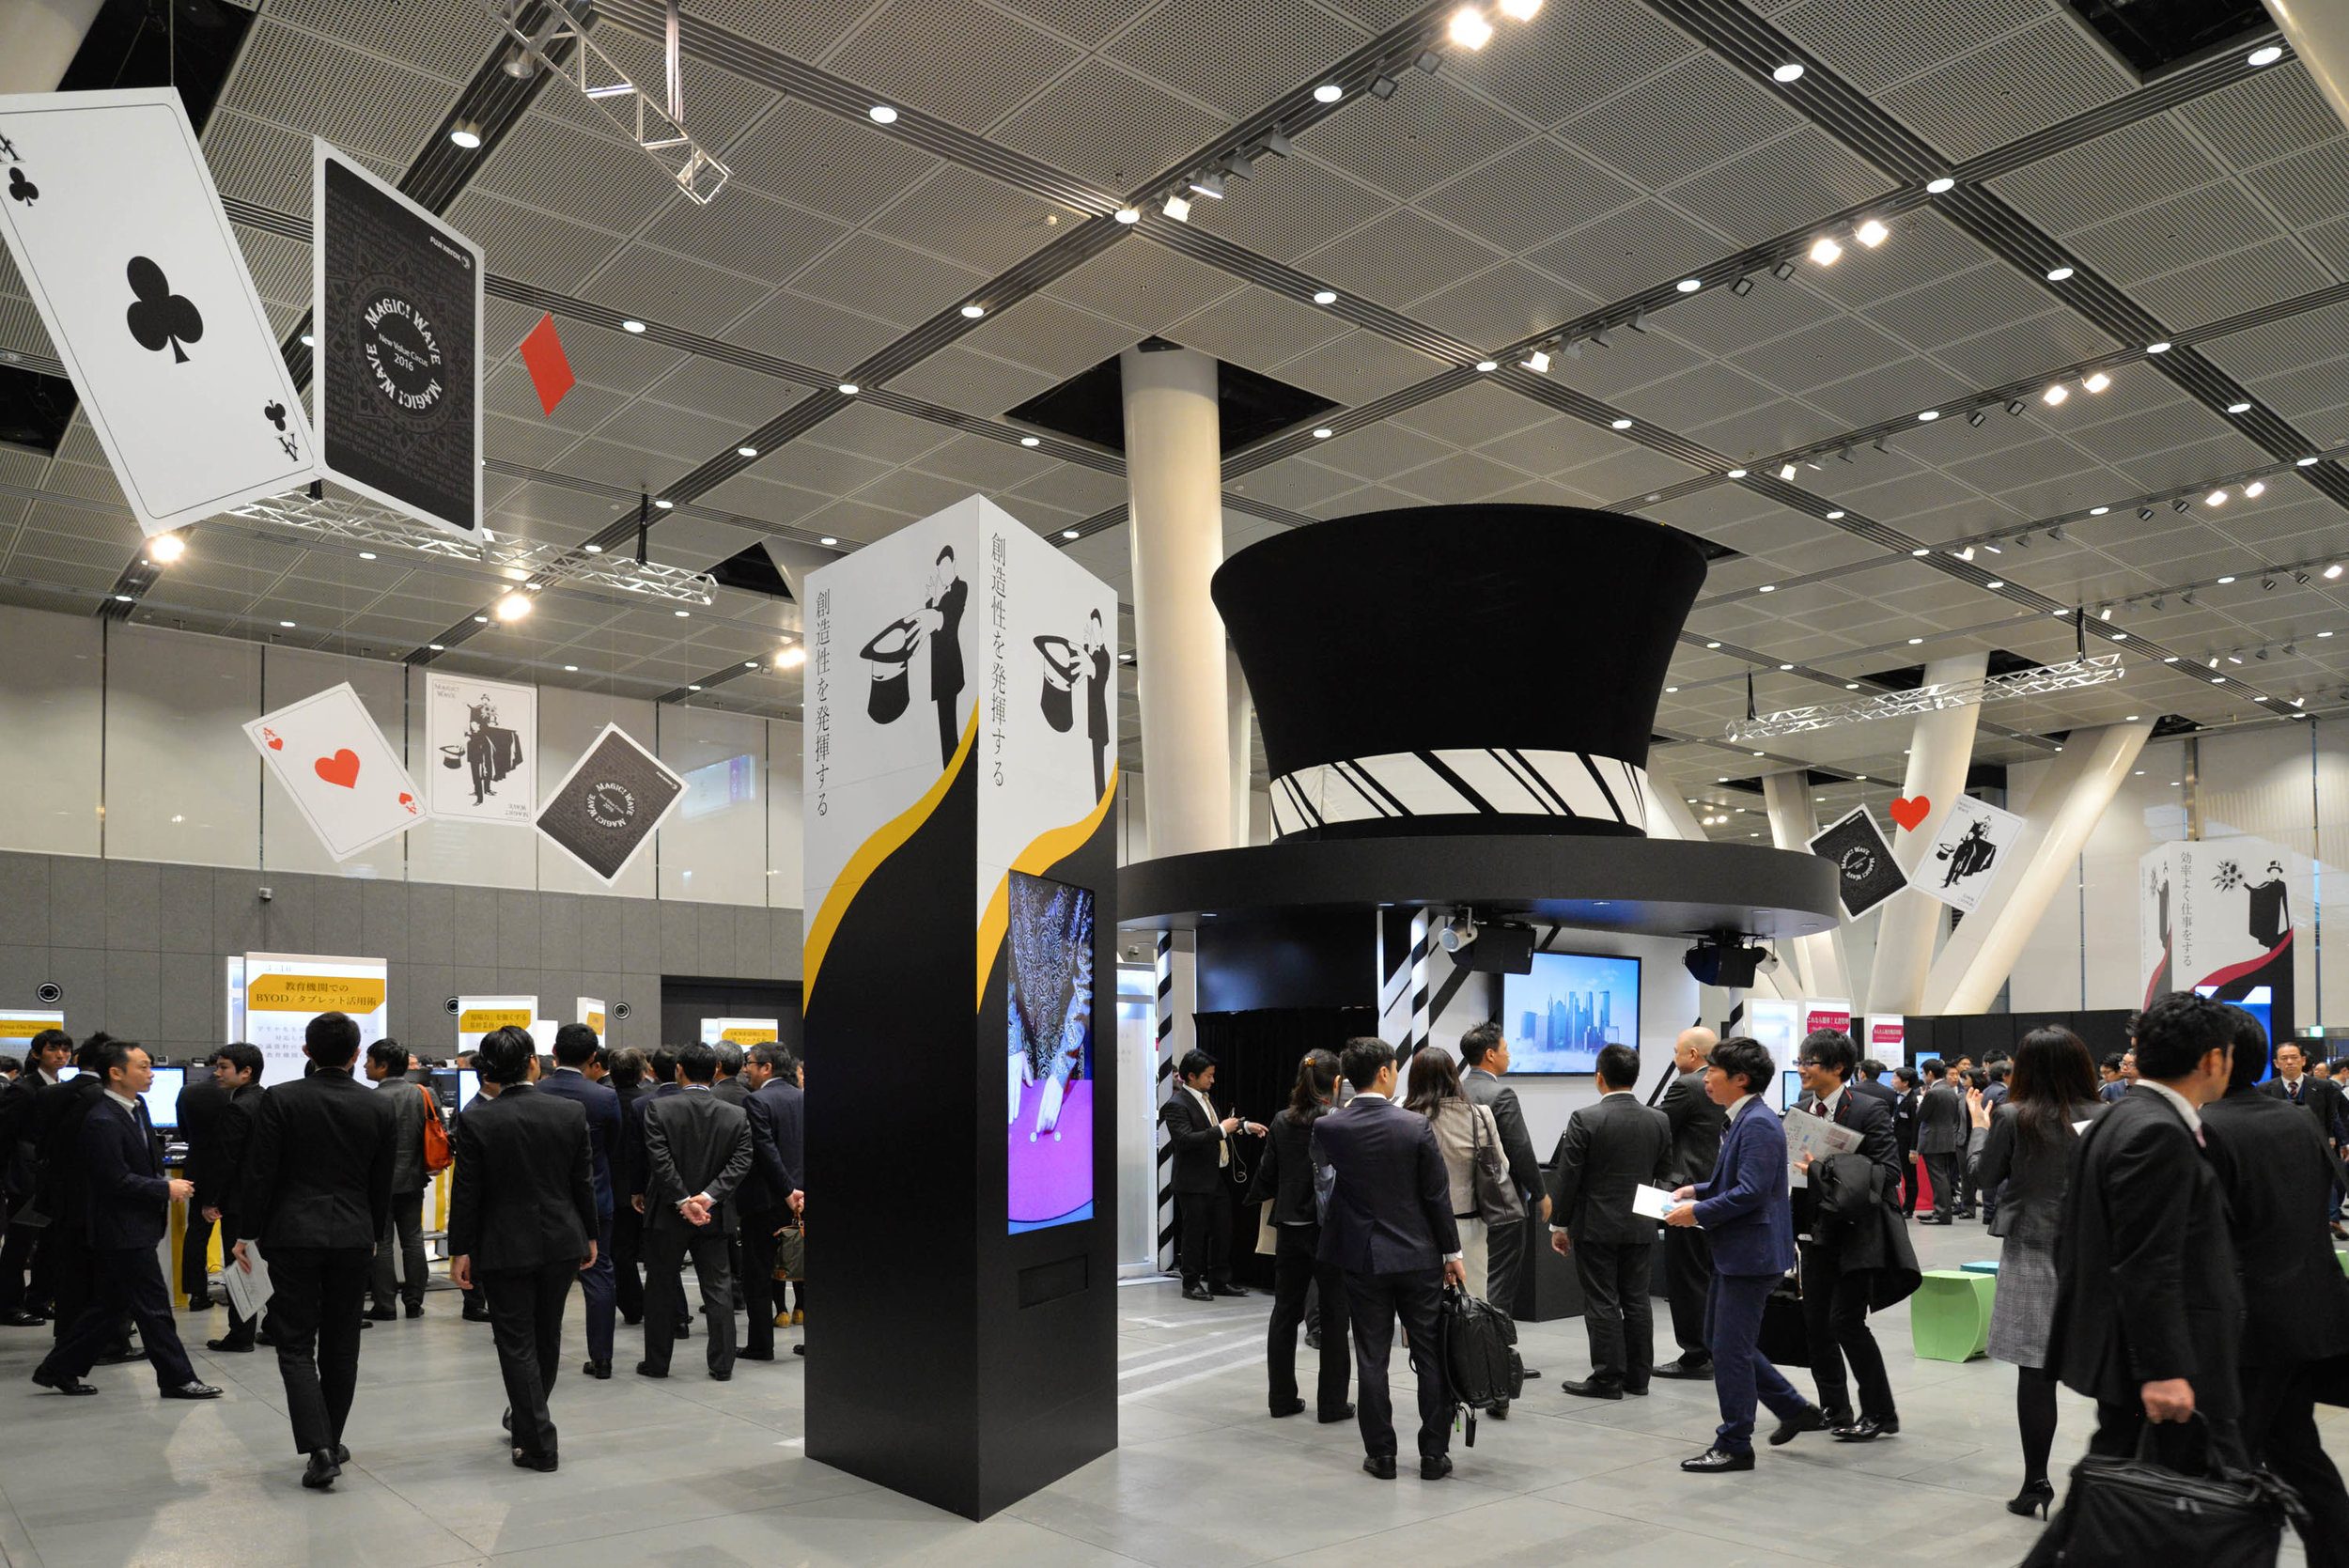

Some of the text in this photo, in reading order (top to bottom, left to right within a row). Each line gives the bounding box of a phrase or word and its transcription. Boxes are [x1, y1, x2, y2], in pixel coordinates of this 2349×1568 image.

[365, 298, 441, 365] MAGIC! WAVE
[379, 333, 428, 367] New Value Circus
[394, 352, 414, 371] 2016
[366, 343, 443, 409] MAGIC! WAVE
[277, 432, 299, 461] A
[990, 532, 1007, 787] 創造性を発揮する
[815, 589, 831, 816] 創造性を発揮する
[587, 794, 627, 827] MAGIC! WAVE
[596, 783, 635, 816] MAGIC! WAVE
[2180, 851, 2193, 967] 効率よく仕事をする
[286, 981, 349, 992] 教育機関での
